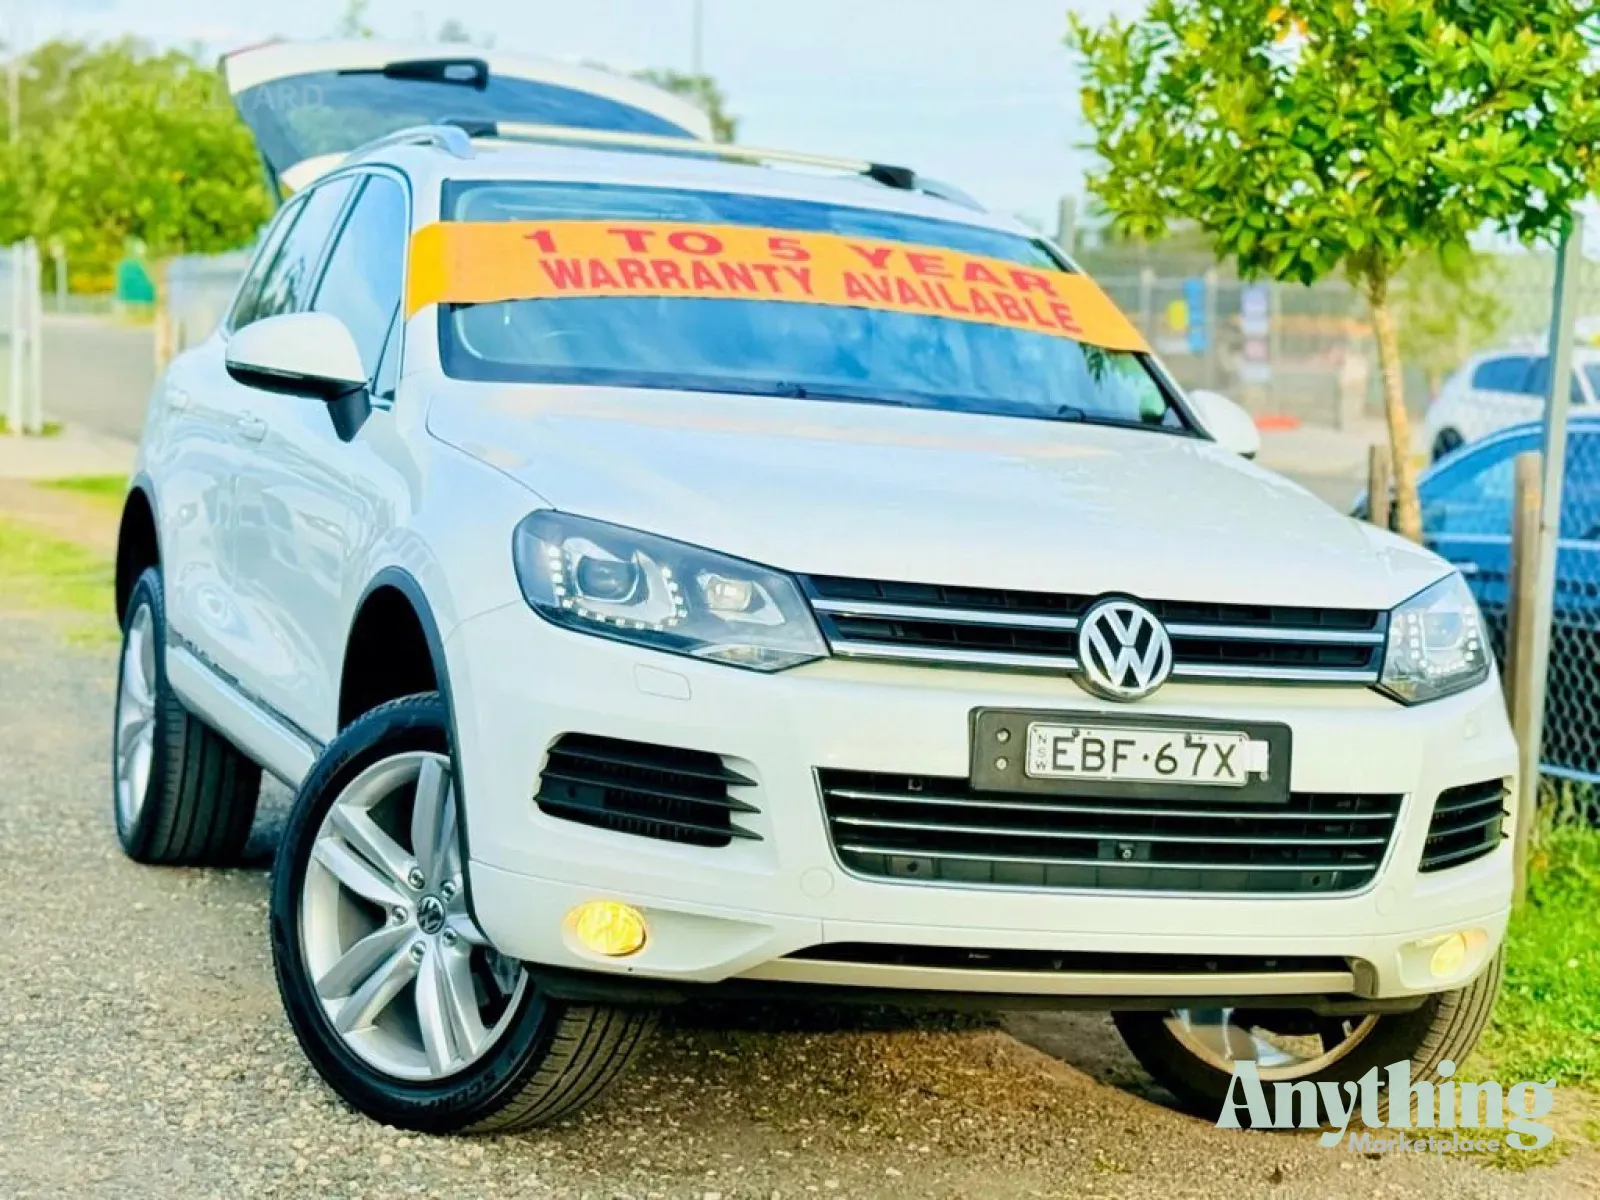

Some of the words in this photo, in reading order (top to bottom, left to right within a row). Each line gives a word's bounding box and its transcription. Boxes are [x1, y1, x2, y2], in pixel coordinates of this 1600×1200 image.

[523, 229, 557, 253] 1
[607, 229, 723, 256] TO
[768, 237, 811, 262] 5
[846, 244, 1059, 297] YEAR
[538, 258, 814, 296] WARRANTY
[843, 272, 1083, 334] AVAILABLE
[1080, 601, 1172, 692] VW
[1036, 733, 1048, 770] NSW
